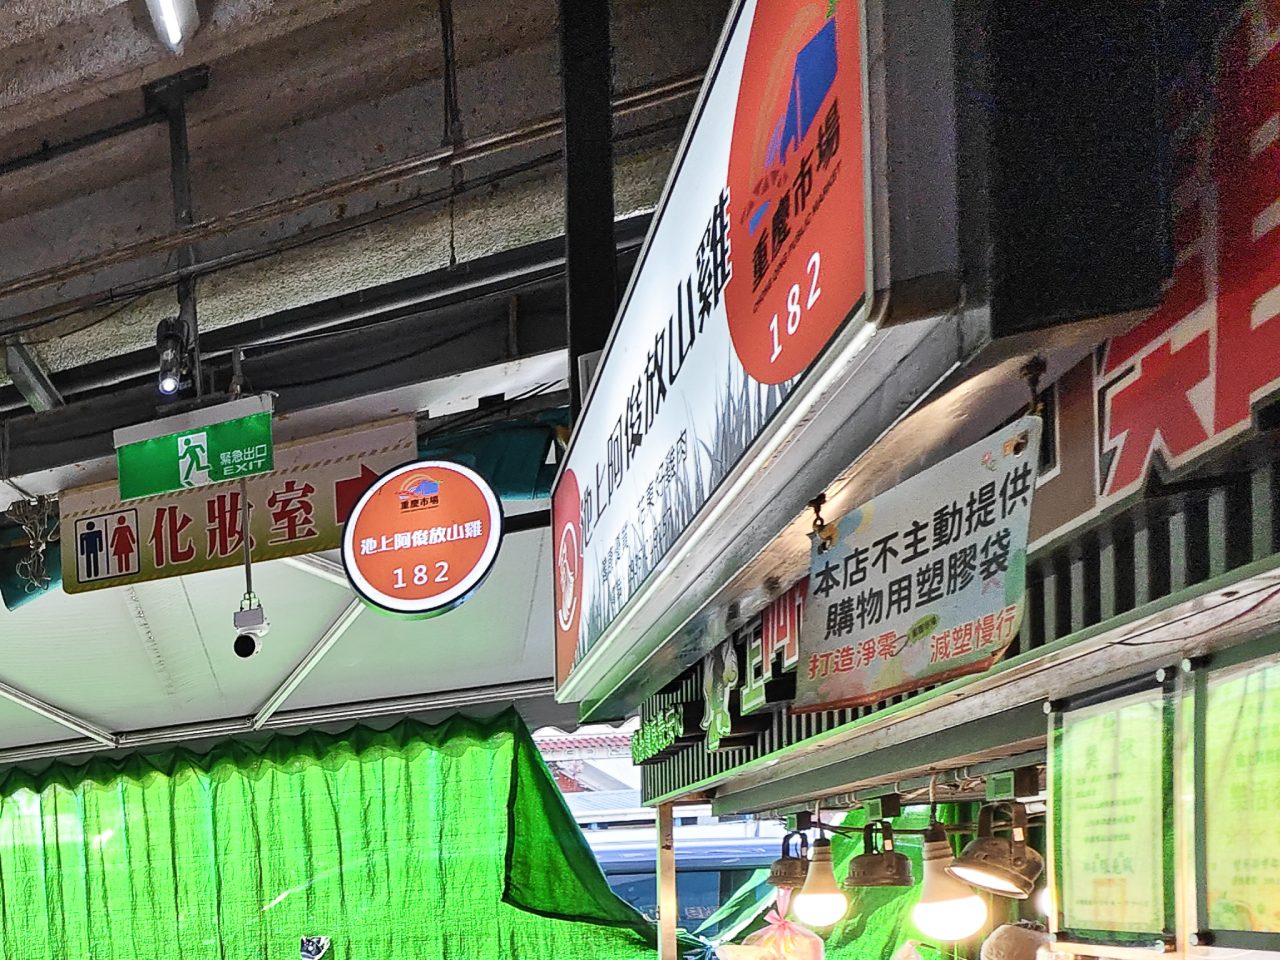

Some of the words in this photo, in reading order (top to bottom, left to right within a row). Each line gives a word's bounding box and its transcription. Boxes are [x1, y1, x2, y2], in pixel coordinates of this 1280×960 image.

[769, 251, 821, 364] 182
[578, 186, 732, 557] 池上阿俊放山雞
[220, 443, 267, 466] 緊急出口
[223, 458, 266, 476] EXIT
[149, 480, 320, 568] 化妝室
[360, 519, 483, 556] 池上阿俊放山雞
[400, 495, 439, 511] 重慶市場
[813, 462, 1032, 598] 本店不主動提供
[392, 561, 450, 590] 182
[824, 527, 1011, 641] 購物用塑膠袋
[808, 630, 899, 680] 打造淨零
[930, 604, 1018, 664] 減塑慢行
